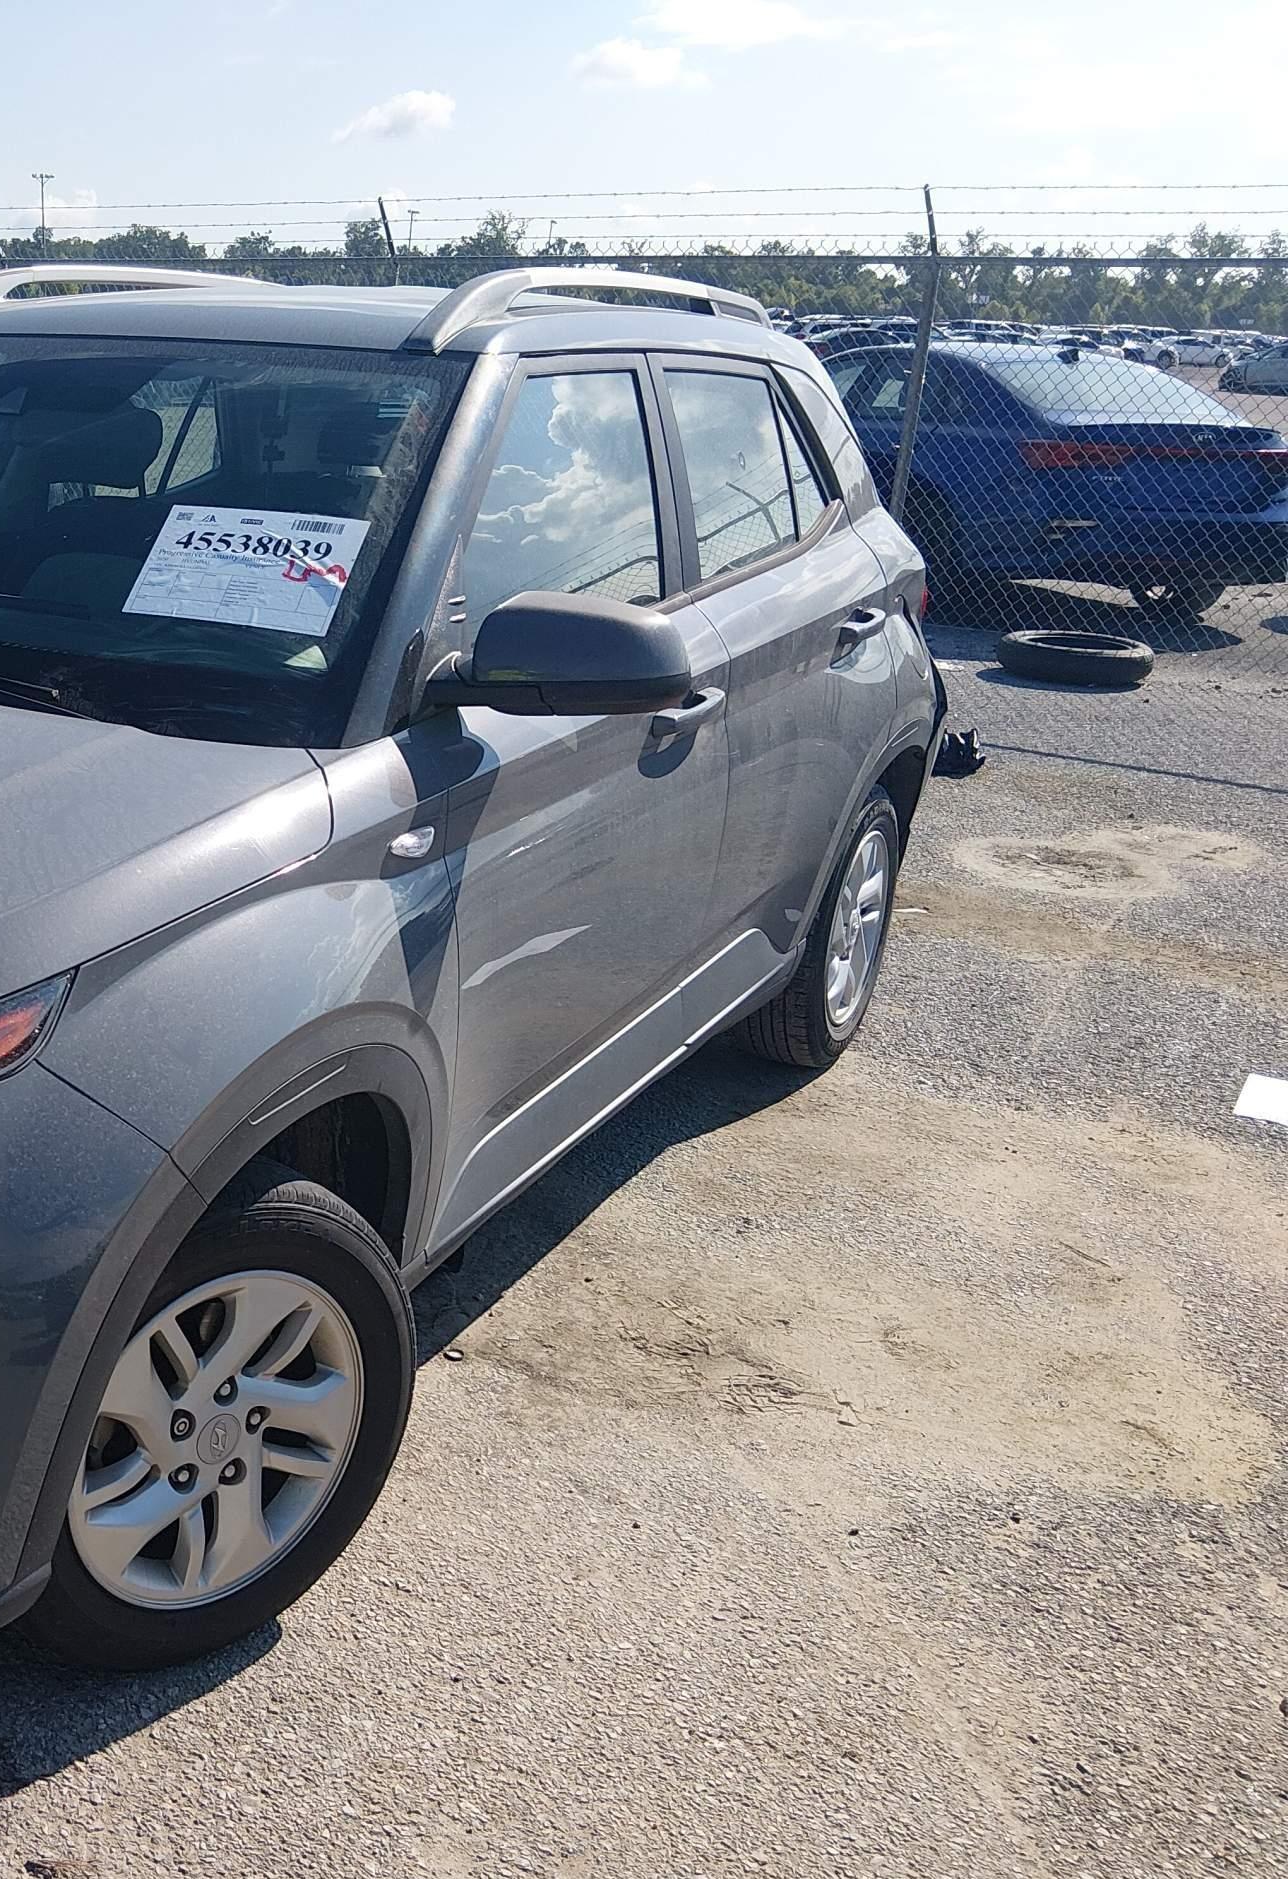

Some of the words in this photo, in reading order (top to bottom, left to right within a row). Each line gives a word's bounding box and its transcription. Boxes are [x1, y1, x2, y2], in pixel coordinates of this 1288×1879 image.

[158, 548, 203, 559] Progressive
[205, 552, 239, 562] Casualty
[175, 530, 333, 561] 45538039
